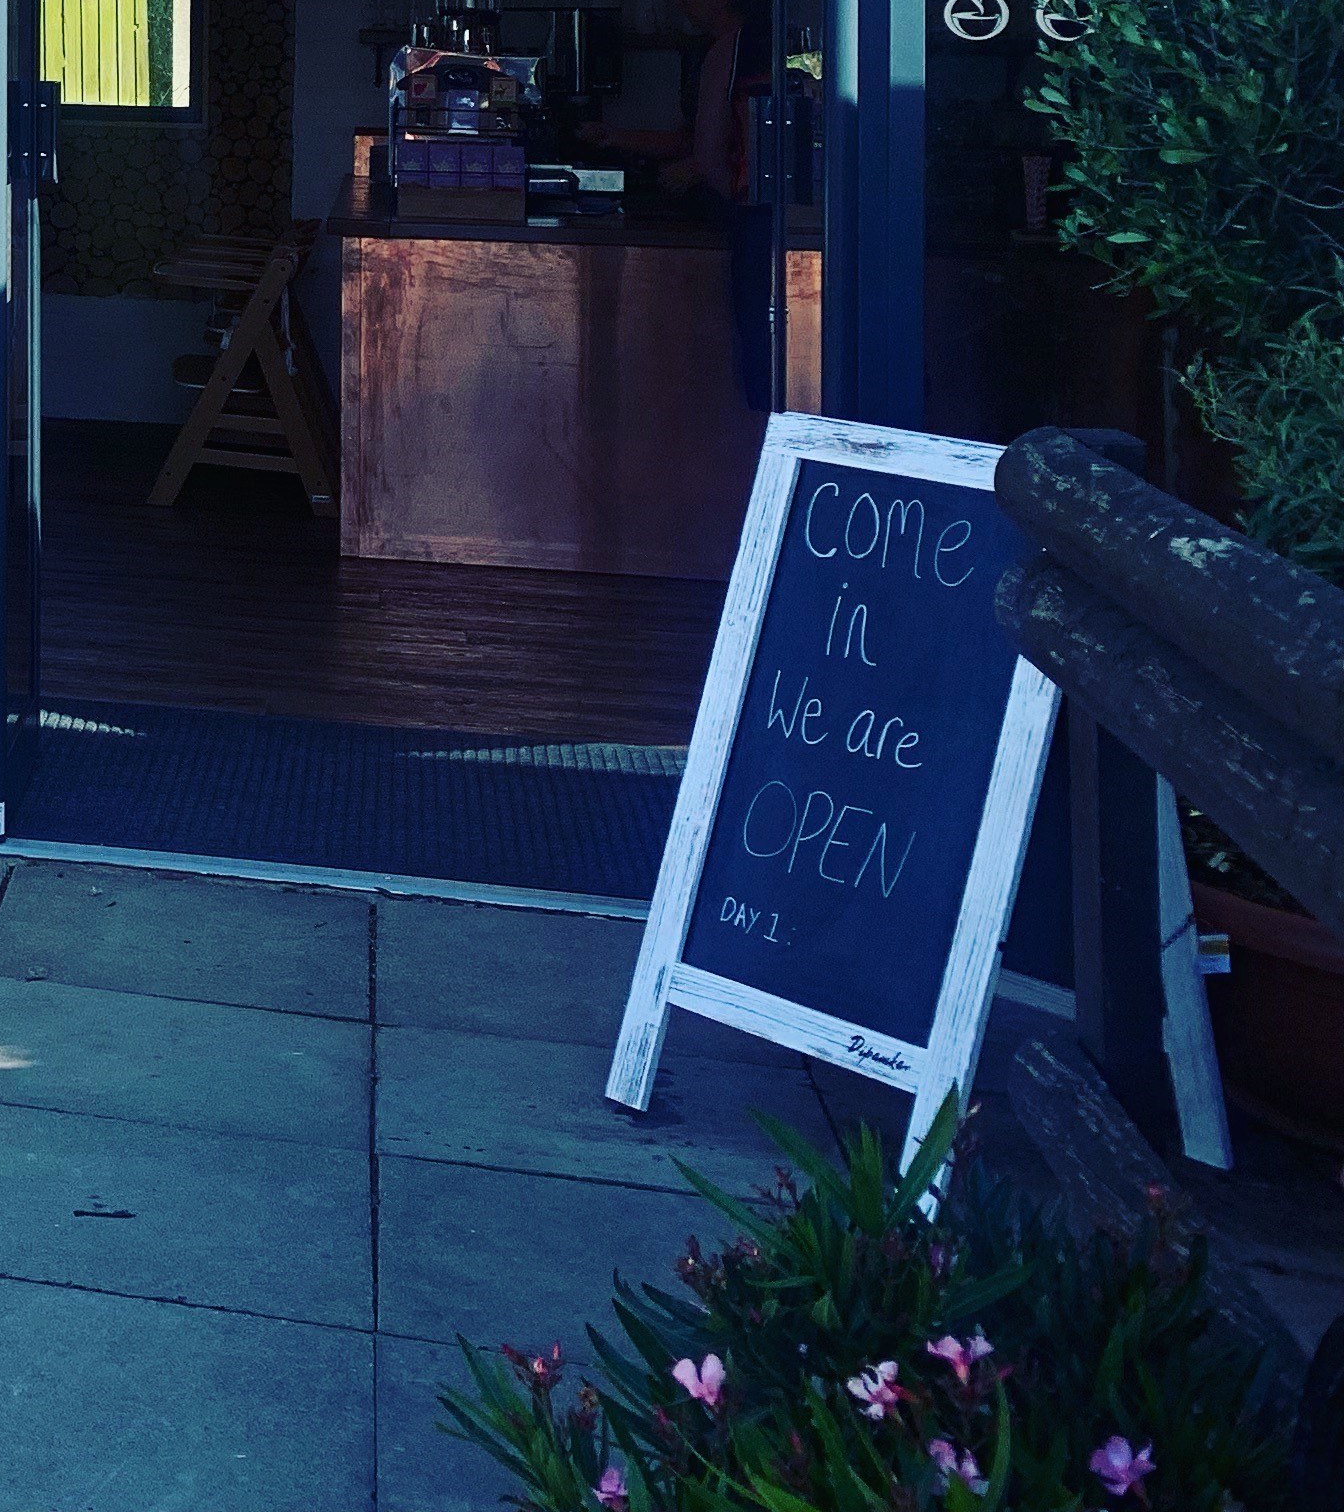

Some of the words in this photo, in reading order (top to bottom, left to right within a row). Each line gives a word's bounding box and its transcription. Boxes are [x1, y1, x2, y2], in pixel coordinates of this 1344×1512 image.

[825, 582, 877, 666] in
[846, 709, 923, 768] are
[743, 780, 917, 899] OPEN
[720, 896, 761, 934] DAY
